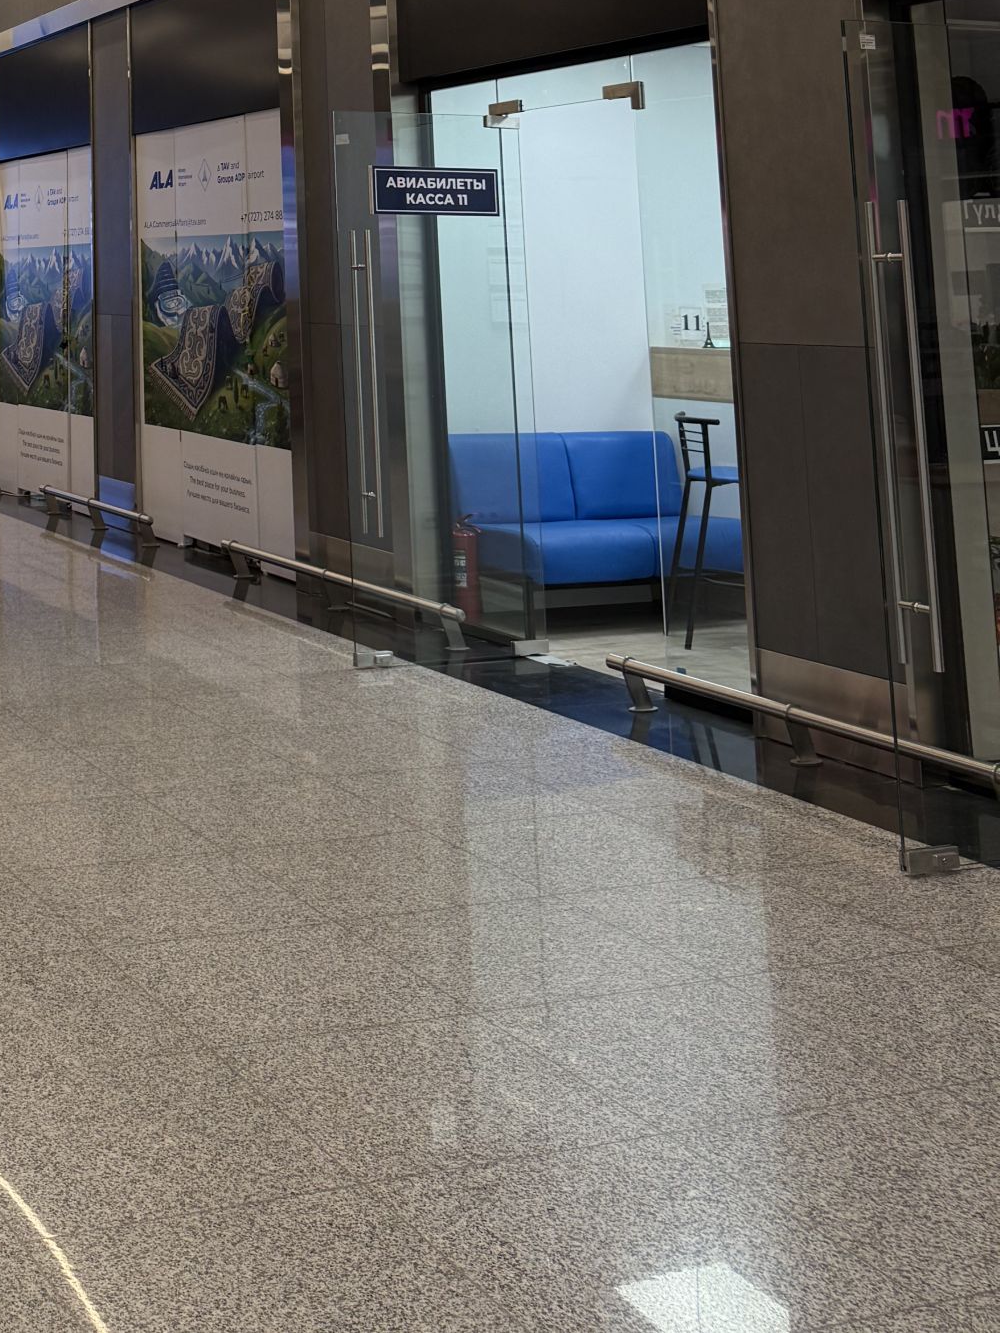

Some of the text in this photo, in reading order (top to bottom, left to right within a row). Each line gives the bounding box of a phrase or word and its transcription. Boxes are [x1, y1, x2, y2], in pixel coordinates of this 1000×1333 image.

[149, 169, 174, 190] ALA
[385, 176, 486, 191] АВИАБИЛЕТЫ
[405, 192, 468, 206] КАССА 11
[963, 199, 1000, 225] Гүл
[681, 313, 701, 332] 11
